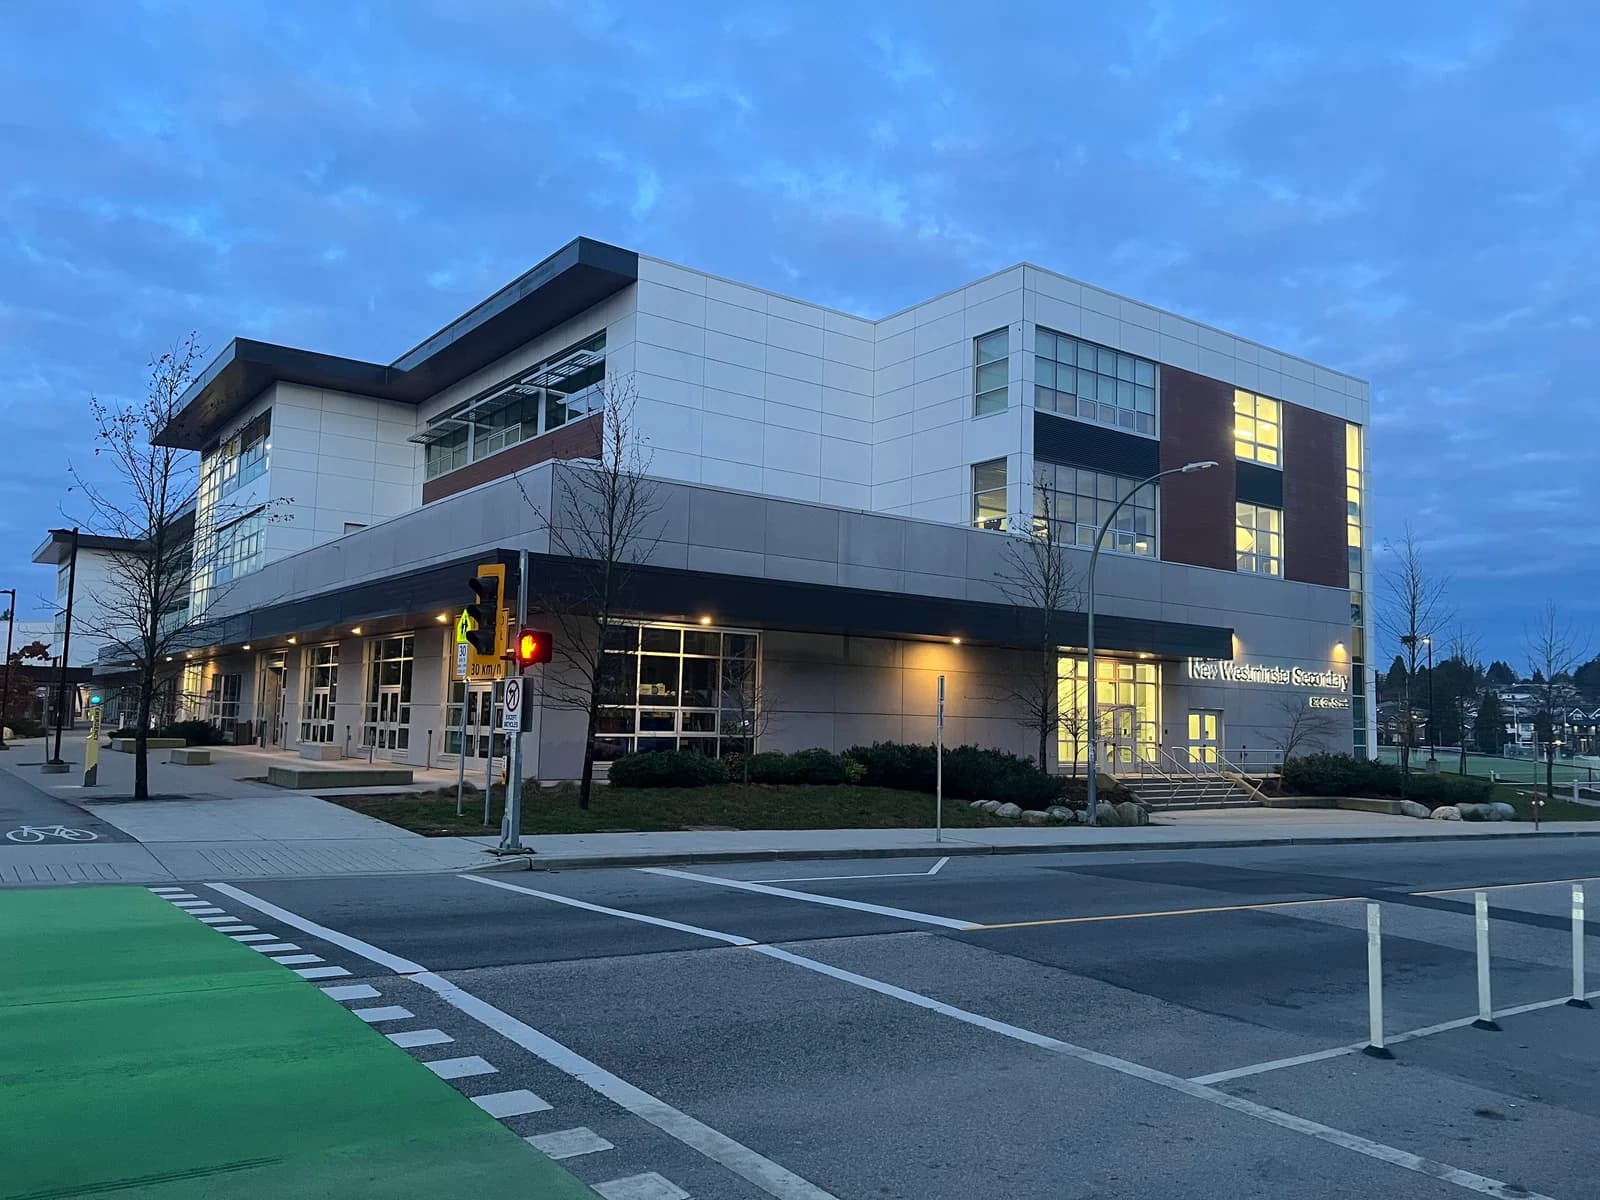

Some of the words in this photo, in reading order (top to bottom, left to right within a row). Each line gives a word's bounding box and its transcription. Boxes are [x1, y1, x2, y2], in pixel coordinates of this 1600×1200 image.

[471, 664, 480, 675] 30
[1188, 657, 1218, 680] New
[1219, 661, 1290, 685] Westminster
[1292, 667, 1349, 692] Secondary
